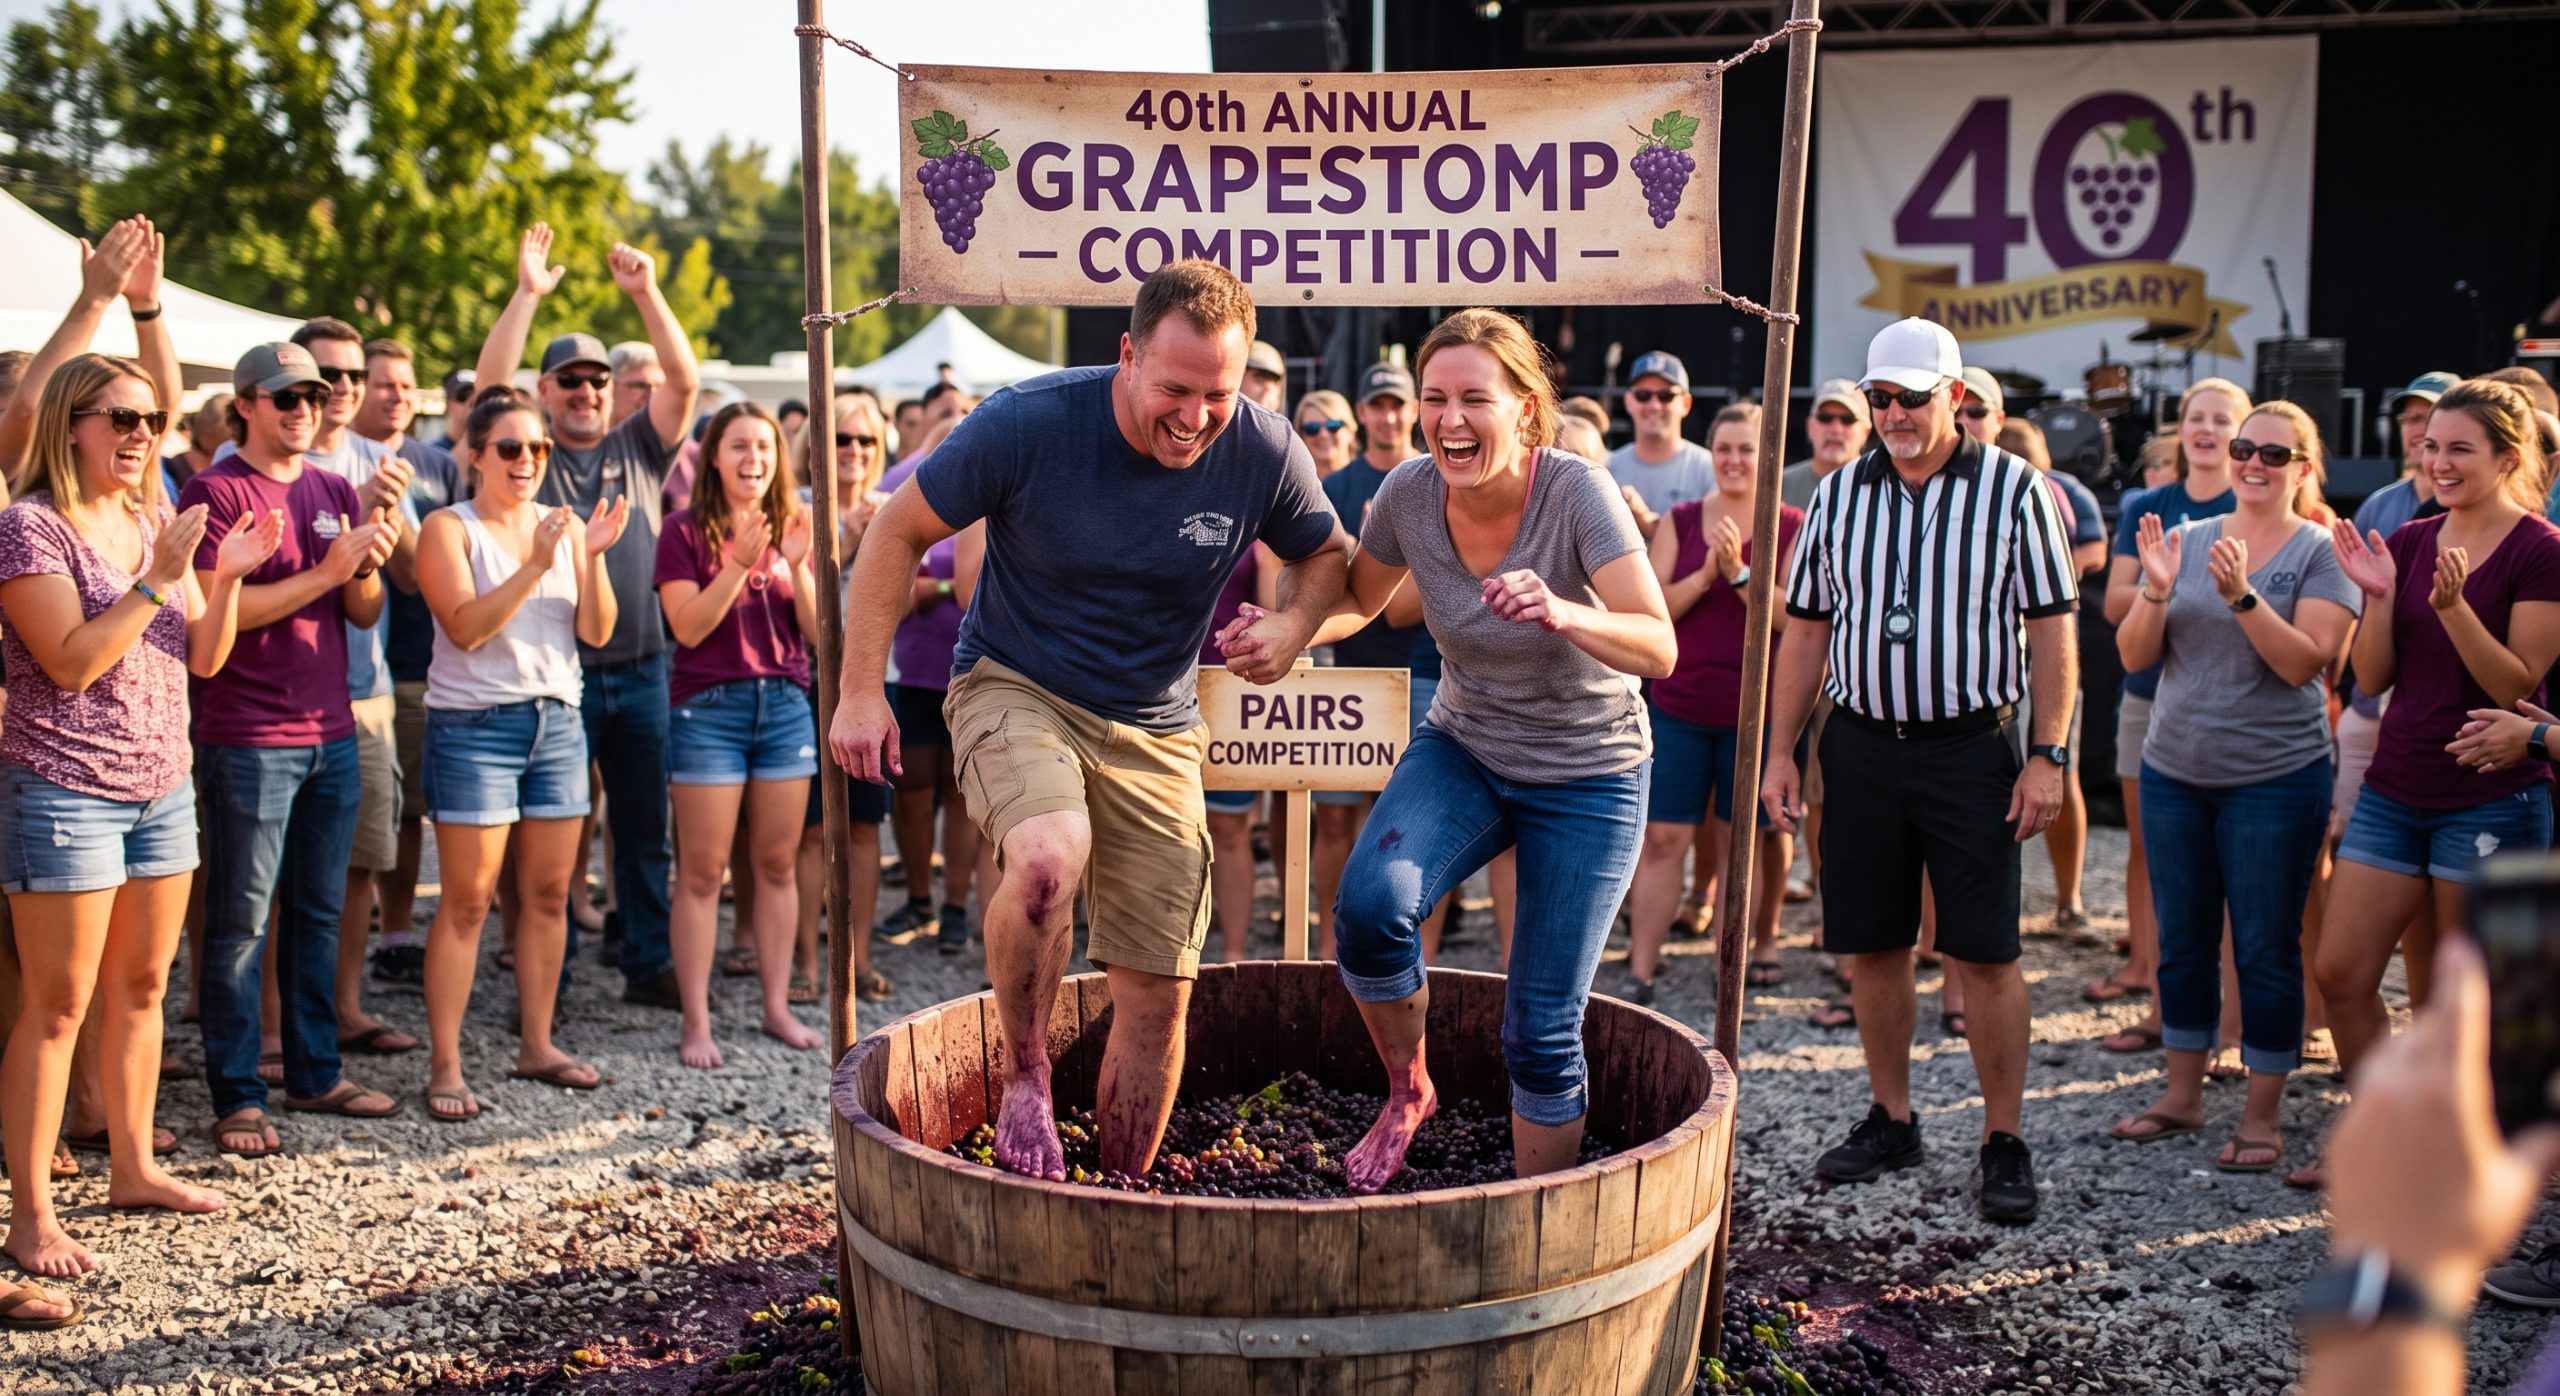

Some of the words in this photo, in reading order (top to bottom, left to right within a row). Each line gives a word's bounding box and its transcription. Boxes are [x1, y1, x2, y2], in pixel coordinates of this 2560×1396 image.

[1126, 89, 1247, 134] 40th
[1263, 89, 1488, 134] ANNUAL
[1016, 142, 1621, 216] GRAPESTOMP
[1079, 226, 1558, 285] COMPETITION
[1920, 272, 2189, 330] ANNIVERSARY
[1240, 694, 1365, 732] PAIRS
[1207, 740, 1395, 767] COMPETITION
